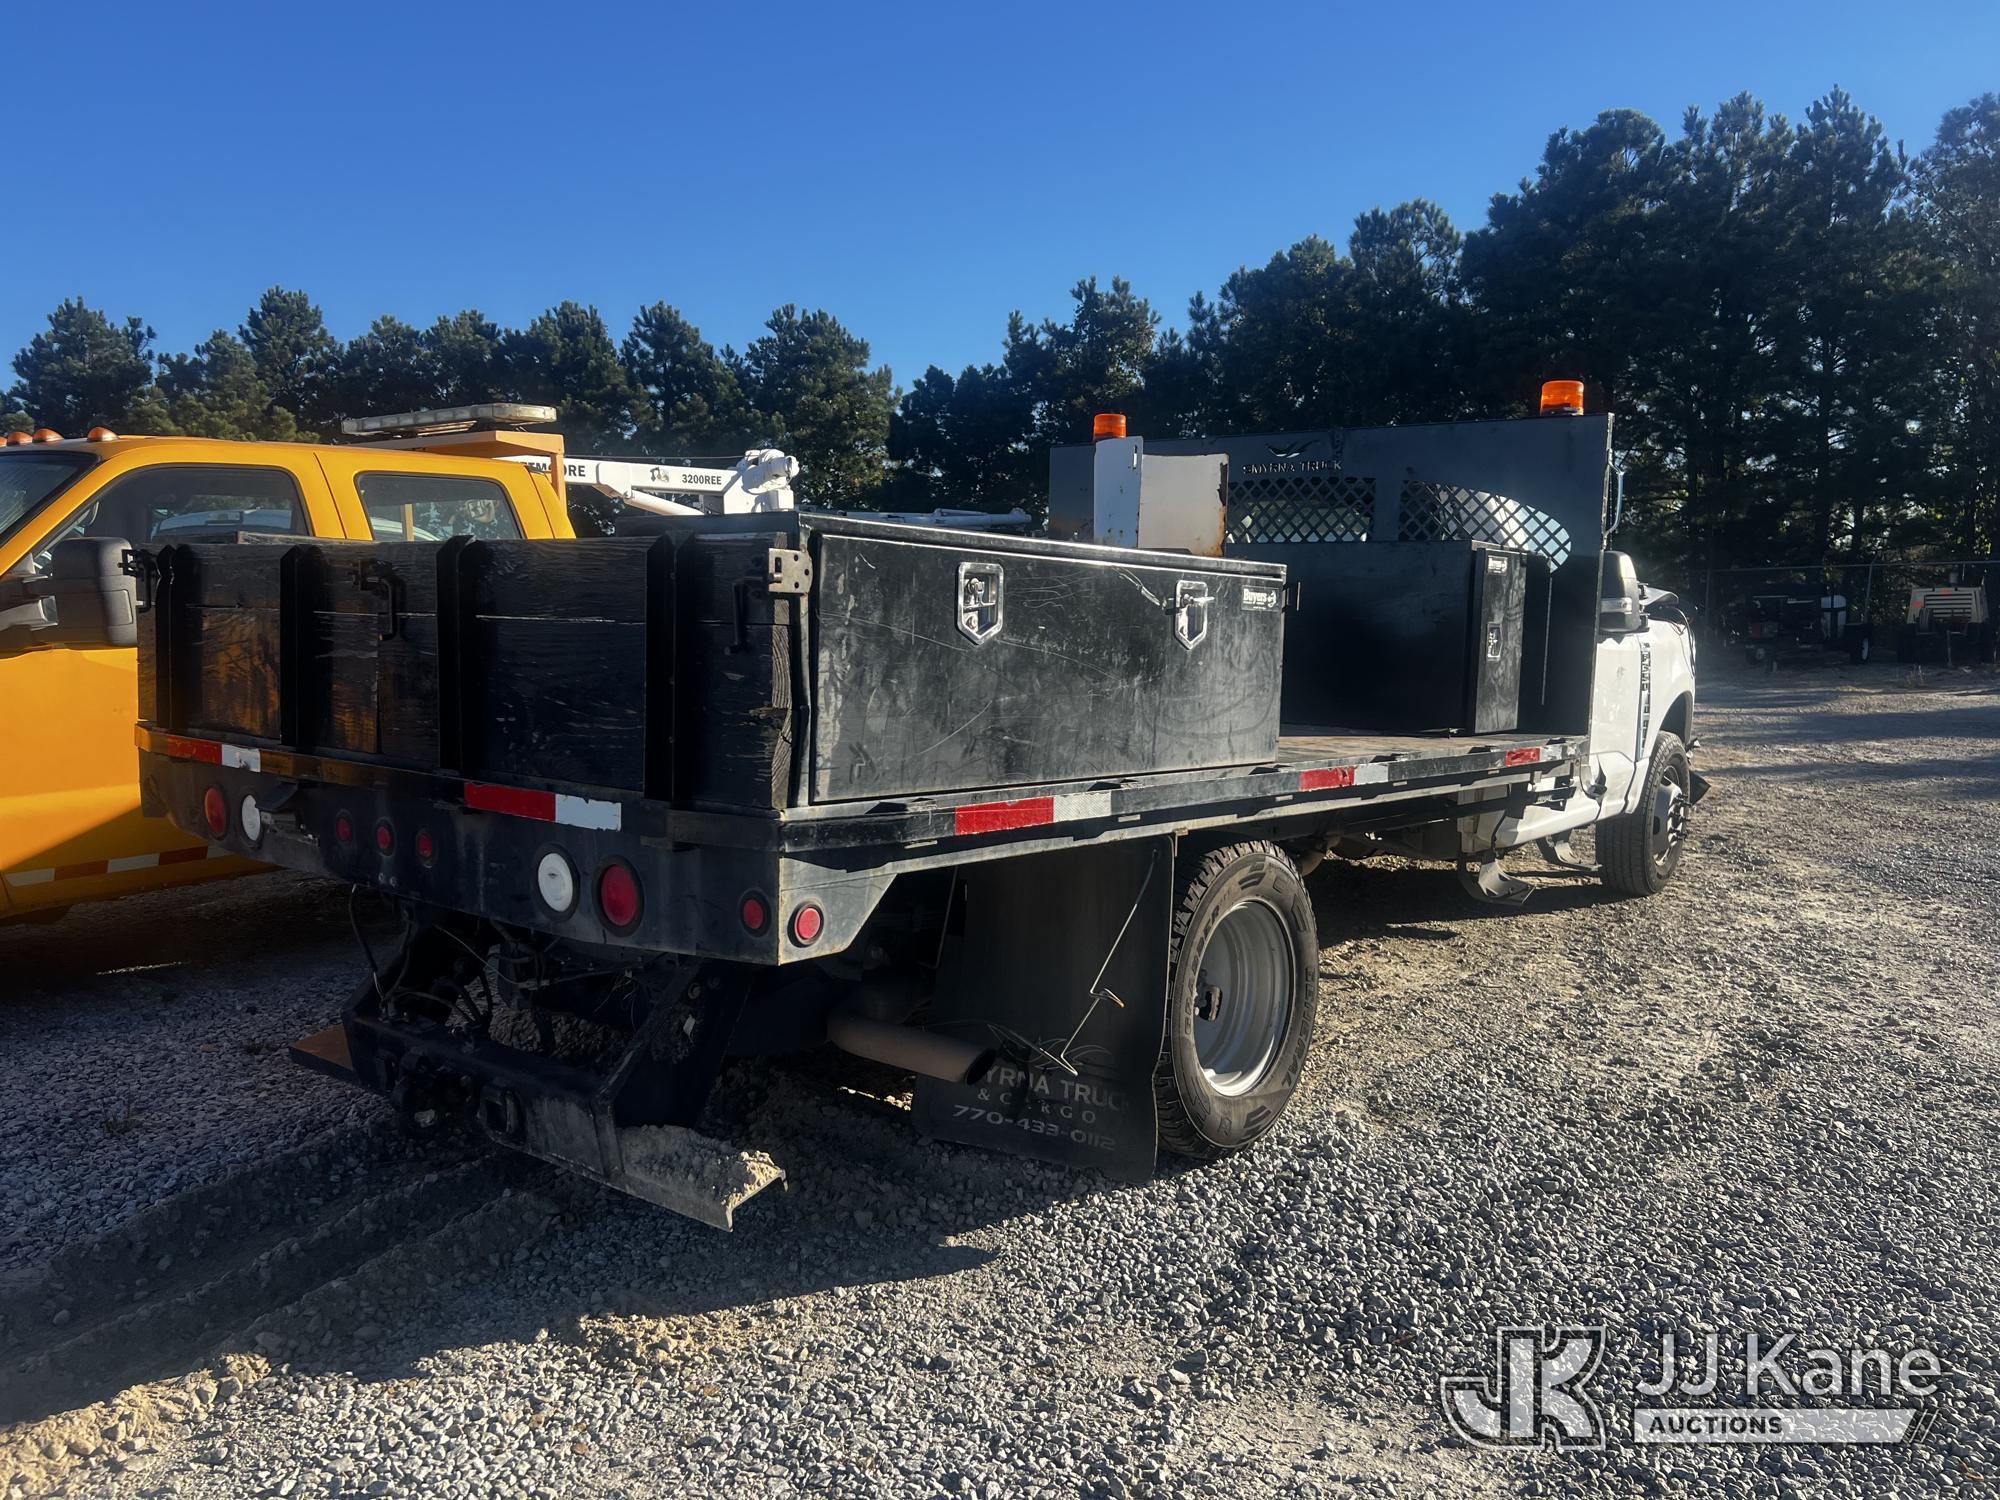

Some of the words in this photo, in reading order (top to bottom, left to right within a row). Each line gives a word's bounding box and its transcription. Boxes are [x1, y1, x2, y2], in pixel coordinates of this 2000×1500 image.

[681, 474, 722, 485] 3200REE
[977, 1088, 991, 1101] &
[986, 1065, 1050, 1095] YRNA
[1060, 1079, 1129, 1112] TRUC
[952, 1105, 1117, 1151] 770-433-0112
